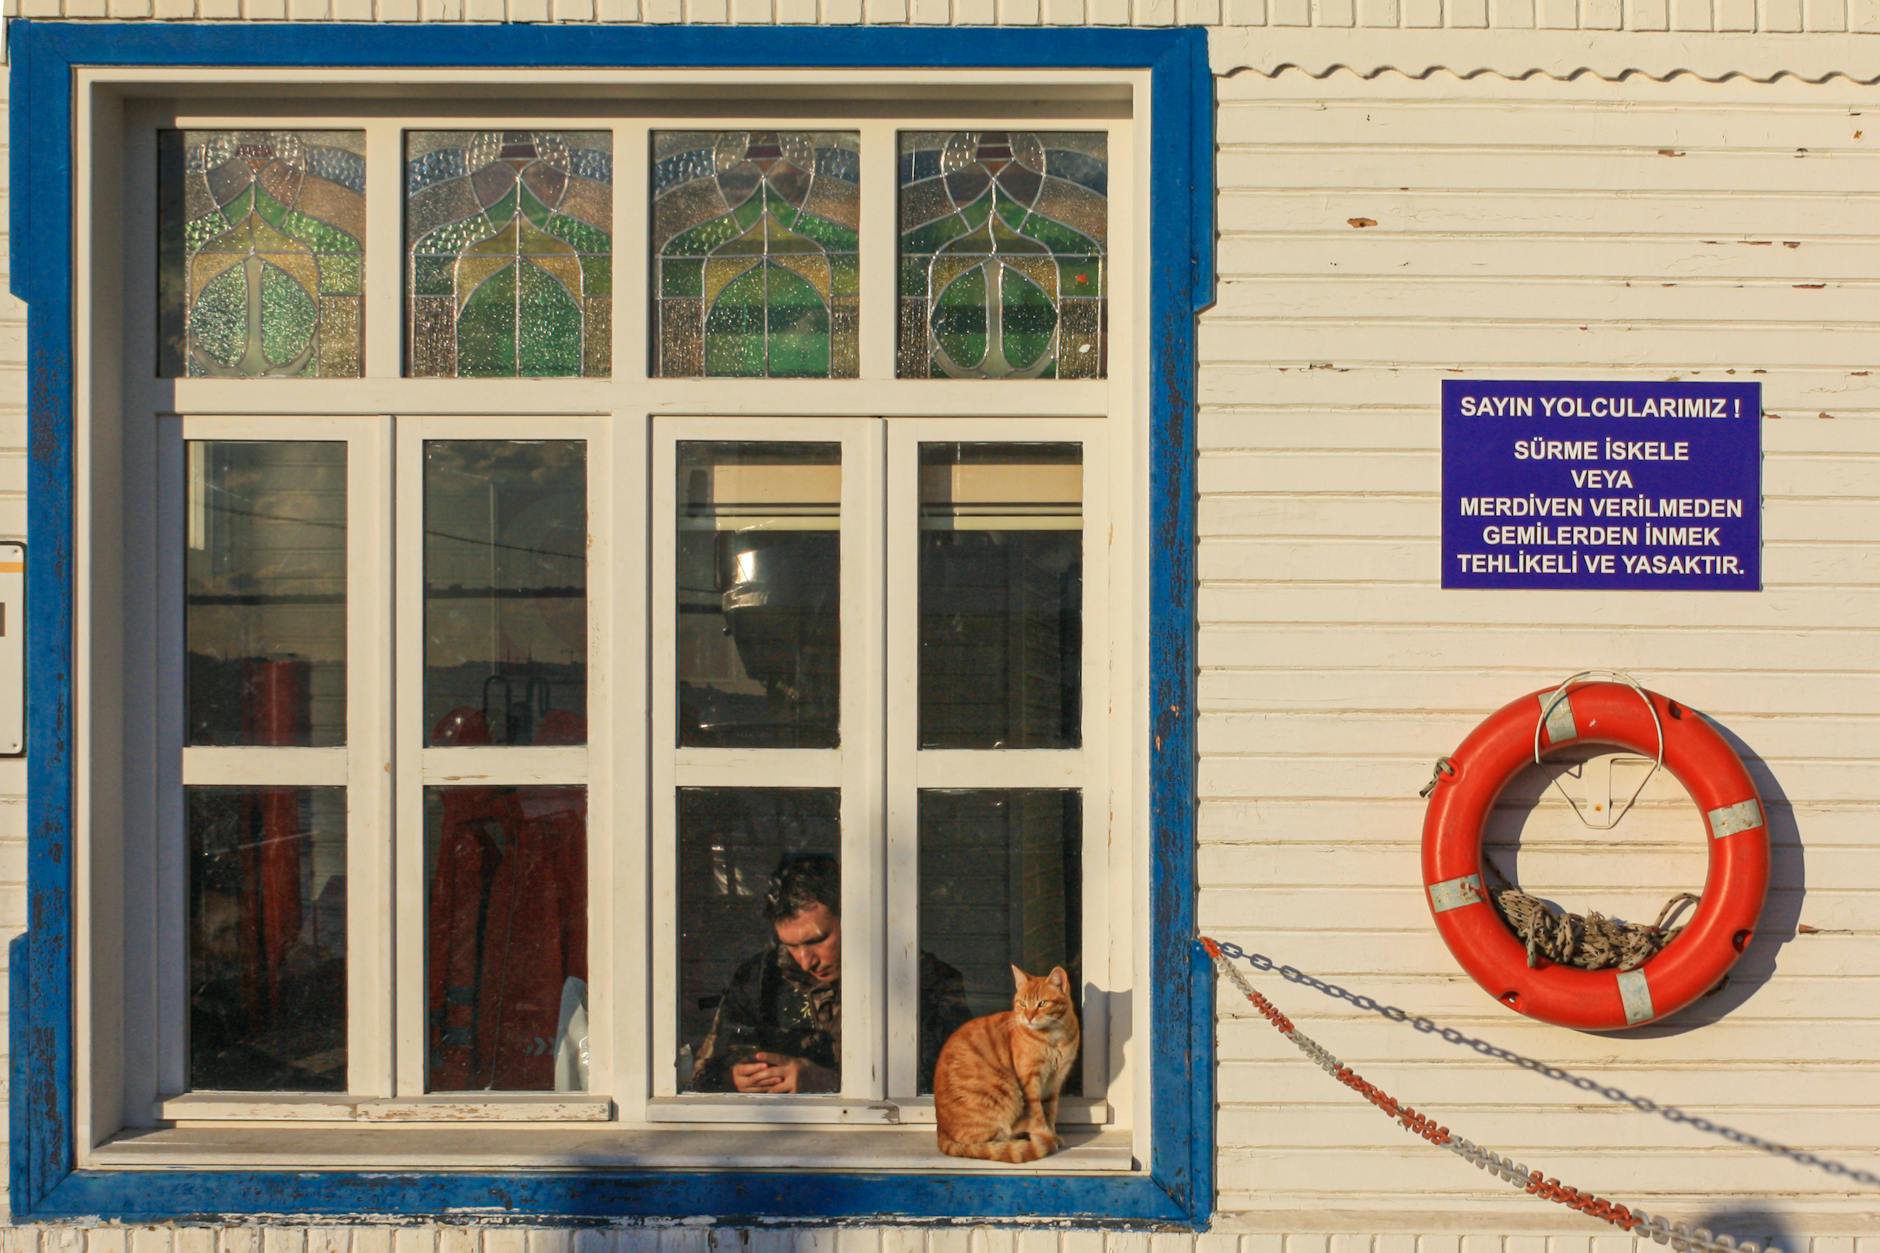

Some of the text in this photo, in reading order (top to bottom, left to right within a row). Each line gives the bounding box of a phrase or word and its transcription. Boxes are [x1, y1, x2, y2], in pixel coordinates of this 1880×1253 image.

[1461, 397, 1740, 418] SAYIN YOLCULARIMIZ !
[1514, 437, 1688, 460] SÜRME İSKELE
[1571, 470, 1633, 488] VEYA
[1461, 494, 1741, 517] MERDİVEN VERİLMEDEN
[1483, 522, 1720, 545] GEMİLERDEN İNMEK
[1457, 550, 1744, 574] TEHLİKELİ VE YASAKTIR.
